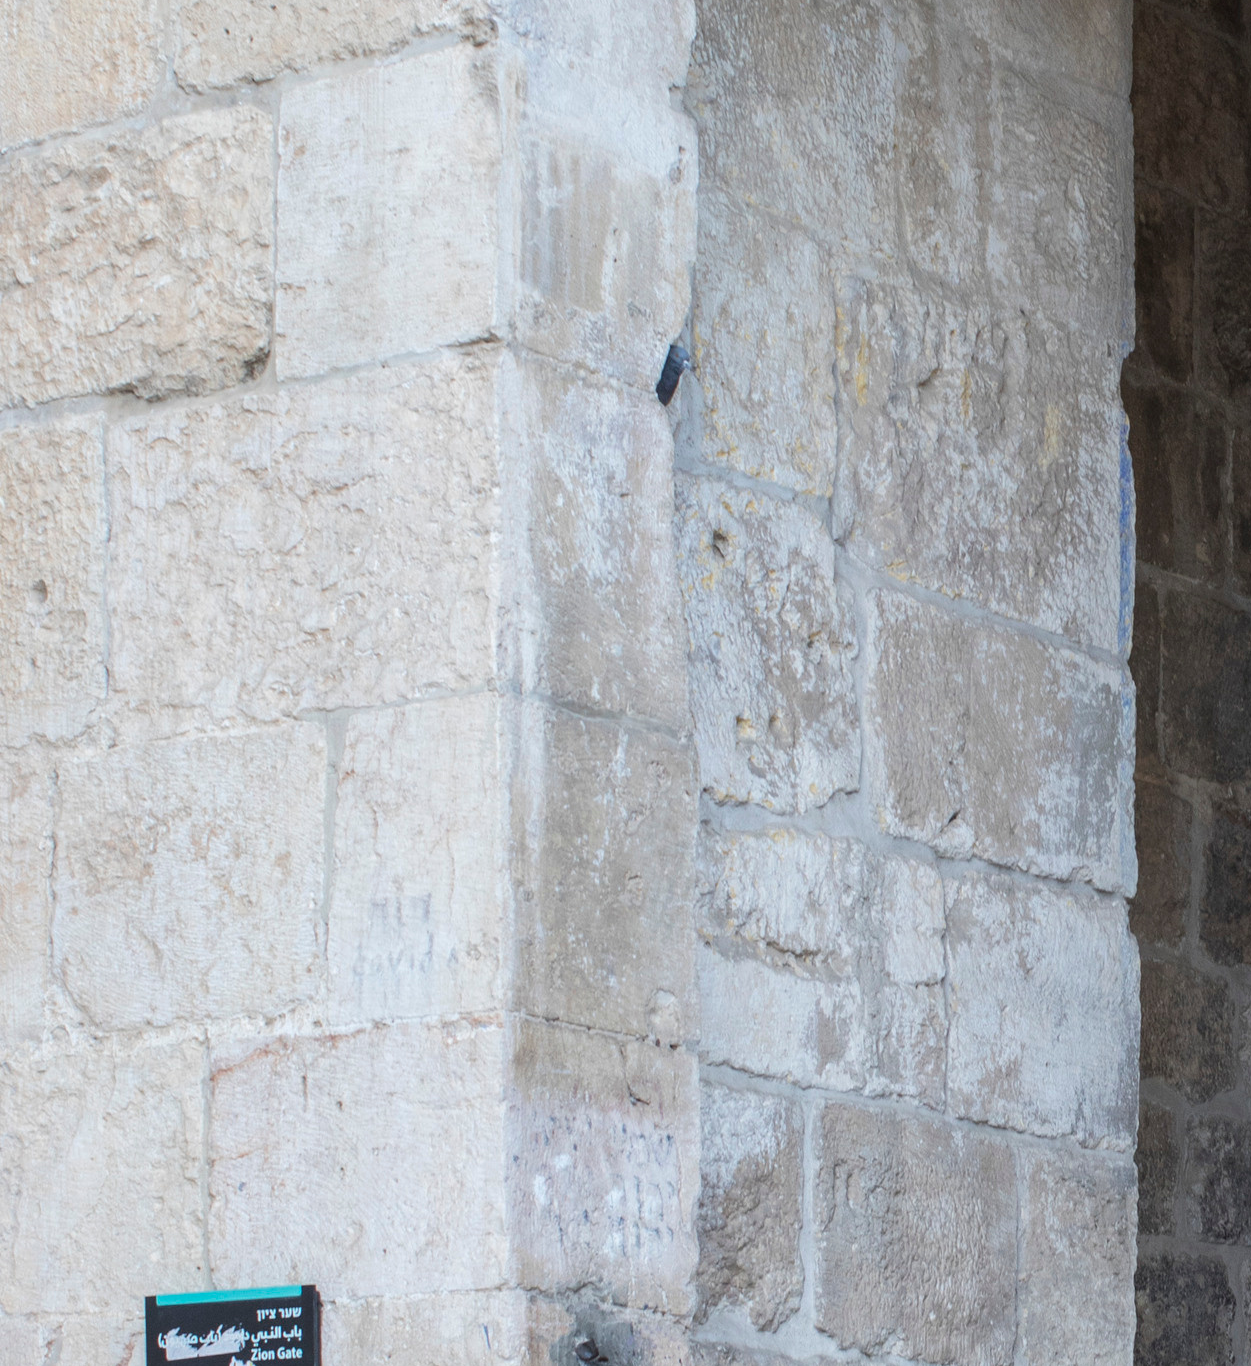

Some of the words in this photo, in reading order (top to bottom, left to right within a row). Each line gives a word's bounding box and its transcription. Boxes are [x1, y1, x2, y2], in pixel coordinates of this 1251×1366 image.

[256, 1308, 276, 1322] ציון
[278, 1306, 302, 1318] שער
[251, 1326, 282, 1347] النبي
[282, 1324, 302, 1342] باب
[251, 1348, 275, 1361] Zion
[277, 1346, 303, 1360] Gate
